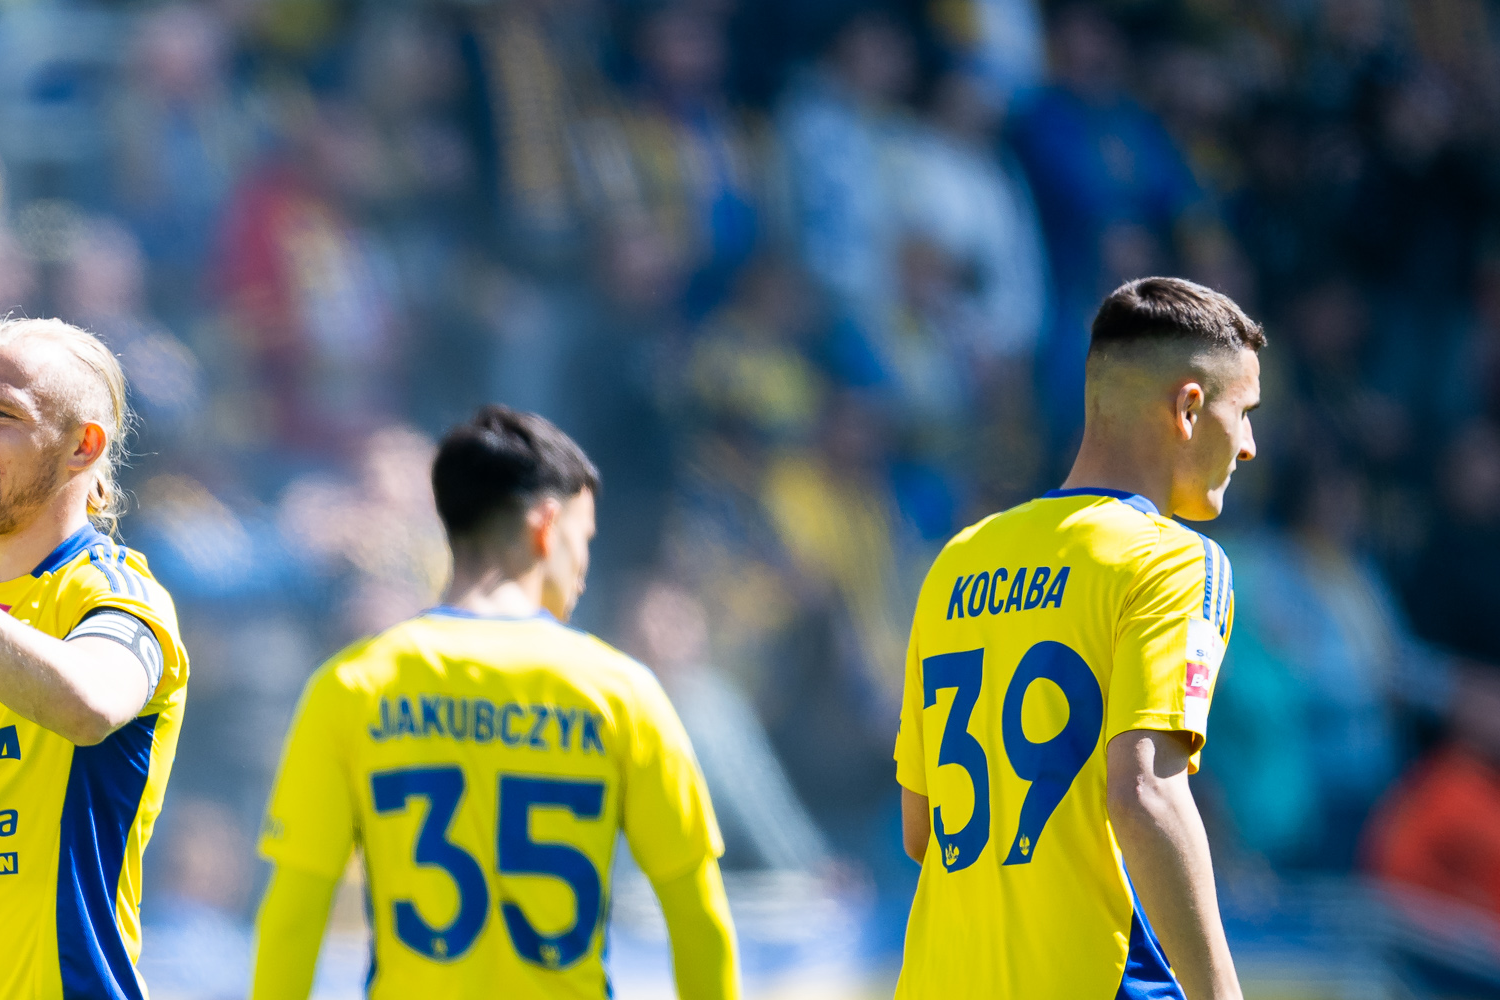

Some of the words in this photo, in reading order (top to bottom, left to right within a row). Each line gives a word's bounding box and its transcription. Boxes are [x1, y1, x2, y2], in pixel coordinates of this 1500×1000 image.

[946, 566, 1070, 620] KOCABA
[369, 695, 606, 755] JAKUBCZYK
[922, 640, 1103, 873] 39
[370, 765, 605, 970] 35
